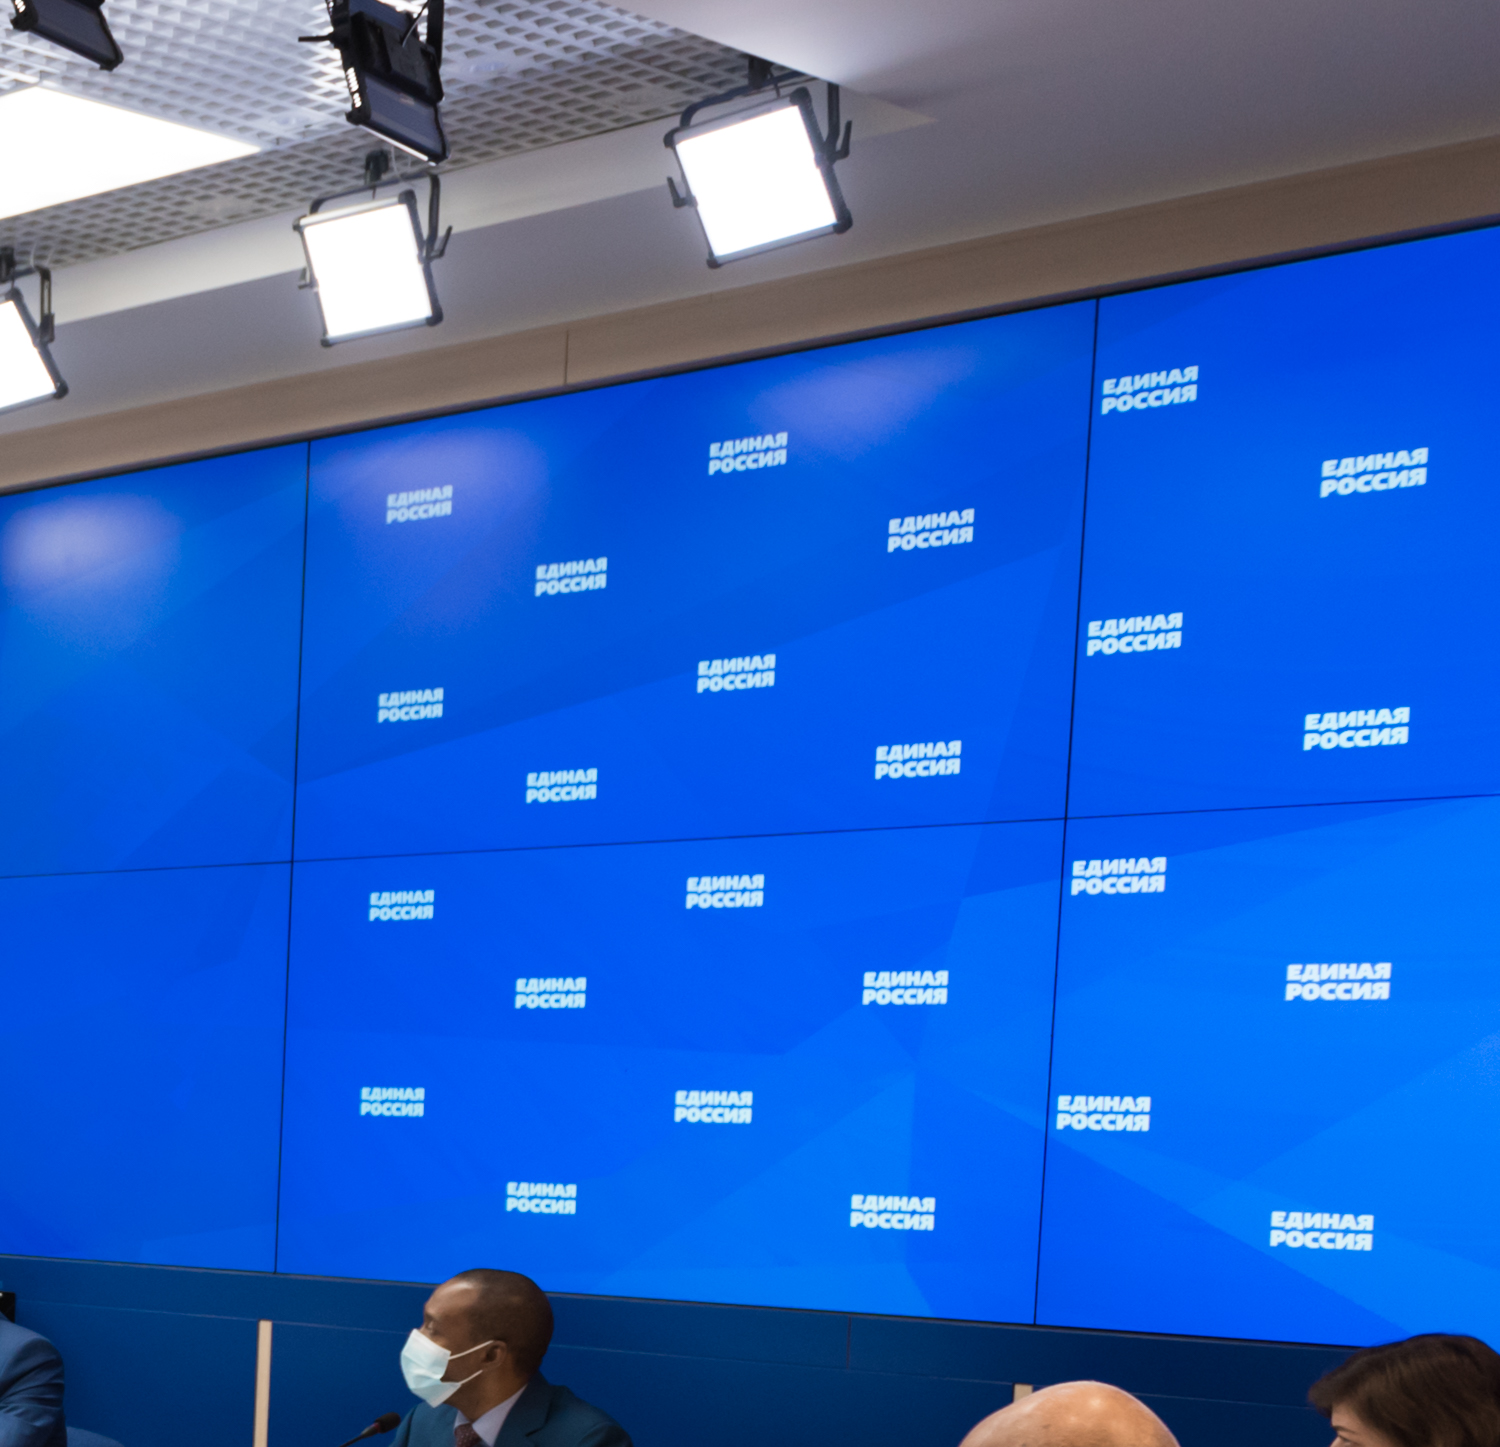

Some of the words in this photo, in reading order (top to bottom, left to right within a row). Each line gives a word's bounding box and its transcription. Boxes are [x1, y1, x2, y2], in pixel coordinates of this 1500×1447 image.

[1103, 366, 1198, 395] ЕДИНАЯ
[1102, 384, 1197, 414] РОССИЯ
[710, 432, 788, 458] ЕДИНАЯ
[709, 448, 787, 475] РОССИЯ
[1322, 448, 1428, 477] ЕДИНАЯ
[1320, 468, 1427, 498] РОССИЯ
[387, 484, 453, 508] ЕДИНАЯ
[387, 500, 452, 523] РОССИЯ
[889, 508, 974, 534] ЕДИНАЯ
[888, 526, 973, 552] РОССИЯ
[536, 557, 607, 580] ЕДИНАЯ
[535, 573, 606, 596] РОССИЯ
[1088, 612, 1183, 638] ЕДИНАЯ
[1087, 631, 1182, 656] РОССИЯ
[698, 654, 776, 676] ЕДИНАЯ
[697, 671, 775, 693] РОССИЯ
[379, 688, 444, 708] ЕДИНАЯ
[378, 703, 443, 722] РОССИЯ
[1305, 707, 1410, 731] ЕДИНАЯ
[1304, 726, 1409, 750] РОССИЯ
[876, 740, 962, 762] ЕДИНАЯ
[527, 768, 597, 787] ЕДИНАЯ
[875, 758, 960, 779] РОССИЯ
[526, 784, 596, 803] РОССИЯ
[1072, 857, 1166, 877] ЕДИНАЯ
[687, 874, 764, 892] ЕДИНАЯ
[1071, 875, 1165, 895] РОССИЯ
[370, 890, 434, 906] ЕДИНАЯ
[686, 891, 764, 909] РОССИЯ
[369, 905, 434, 921] РОССИЯ
[864, 970, 948, 988] ЕДИНАЯ
[1287, 962, 1392, 982] ЕДИНАЯ
[516, 977, 586, 993] ЕДИНАЯ
[1286, 982, 1390, 1000] РОССИЯ
[515, 993, 586, 1008] РОССИЯ
[862, 988, 948, 1005] РОССИЯ
[361, 1087, 425, 1102] ЕДИНАЯ
[675, 1090, 753, 1106] ЕДИНАЯ
[1058, 1096, 1151, 1112] ЕДИНАЯ
[361, 1102, 424, 1116] РОССИЯ
[674, 1106, 752, 1124] РОССИЯ
[1056, 1112, 1150, 1131] РОССИЯ
[507, 1182, 576, 1198] ЕДИНАЯ
[506, 1197, 576, 1214] РОССИЯ
[851, 1194, 935, 1212] ЕДИНАЯ
[850, 1211, 934, 1230] РОССИЯ
[1271, 1211, 1374, 1230] ЕДИНАЯ
[1270, 1230, 1373, 1251] РОССИЯ
